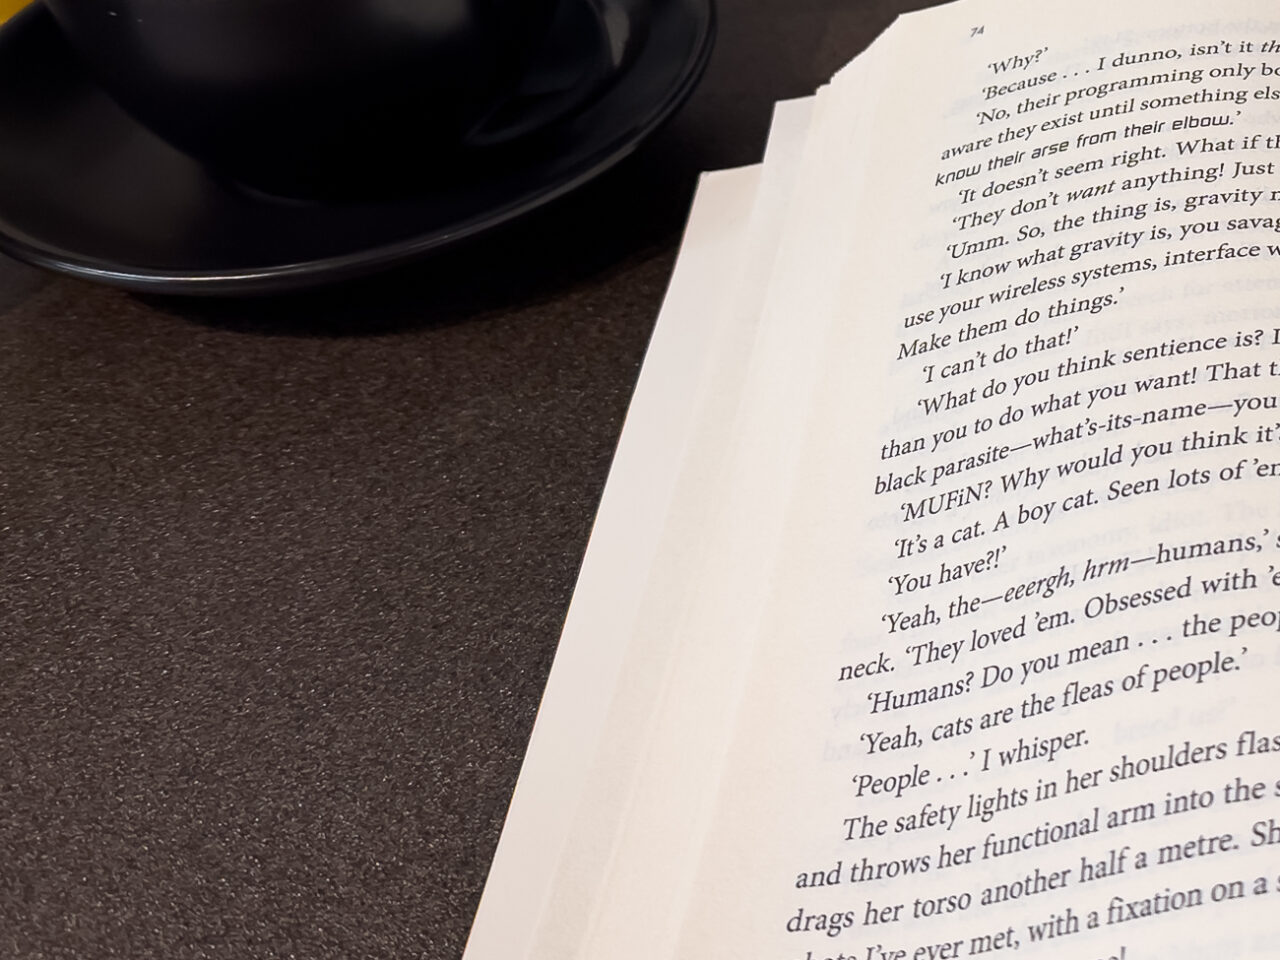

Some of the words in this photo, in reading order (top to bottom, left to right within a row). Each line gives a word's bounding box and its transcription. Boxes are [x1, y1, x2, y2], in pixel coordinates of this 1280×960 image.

[970, 25, 985, 38] 74
[987, 46, 1049, 75] ‘Why?’
[934, 163, 982, 187] know
[987, 150, 1027, 172] their
[1030, 140, 1070, 160] arse
[1076, 130, 1117, 149] from
[1123, 120, 1167, 139] their
[1171, 110, 1242, 131] elbow.’
[958, 188, 977, 205] ‘It
[981, 167, 1050, 198] doesn’t
[1053, 158, 1104, 180] seem
[1110, 145, 1167, 169] right.
[1175, 137, 1236, 156] What
[1241, 133, 1263, 150] if
[952, 208, 1006, 231] ‘They
[1010, 191, 1060, 217] don’t
[1066, 179, 1117, 203] want
[1120, 162, 1225, 192] anything!
[1231, 161, 1276, 180] Just
[896, 332, 952, 361] Make
[958, 318, 1008, 344] them
[1014, 307, 1041, 327] do
[1047, 286, 1125, 319] things.’
[922, 364, 936, 384] ‘I
[940, 350, 988, 379] can’t
[992, 343, 1018, 364] do
[1025, 325, 1080, 355] that!’
[894, 533, 928, 559] ‘It’s
[933, 534, 945, 550] a
[951, 520, 986, 544] cat.
[992, 510, 1011, 533] A
[1017, 501, 1057, 525] boy
[1061, 488, 1099, 512] cat.
[1107, 477, 1160, 501] Seen
[1167, 468, 1211, 490] lots
[1218, 458, 1249, 482] of
[900, 479, 994, 523] ‘MUFiN?
[1000, 466, 1051, 494] Why
[1056, 443, 1124, 478] would
[1130, 440, 1173, 468] you
[1181, 425, 1249, 452] think
[887, 573, 932, 596] ‘You
[937, 544, 1007, 585] have?!’
[837, 651, 895, 682] neck.
[905, 639, 966, 667] ‘They
[969, 614, 1027, 652] loved
[1034, 610, 1075, 633] ’em.
[1084, 575, 1192, 619] Obsessed
[1200, 567, 1258, 595] with
[859, 724, 923, 755] ‘Yeah,
[931, 716, 974, 742] cats
[979, 706, 1014, 731] are
[1020, 692, 1056, 719] the
[1061, 679, 1115, 708] fleas
[1121, 663, 1150, 692] of
[1151, 646, 1248, 693] people.’
